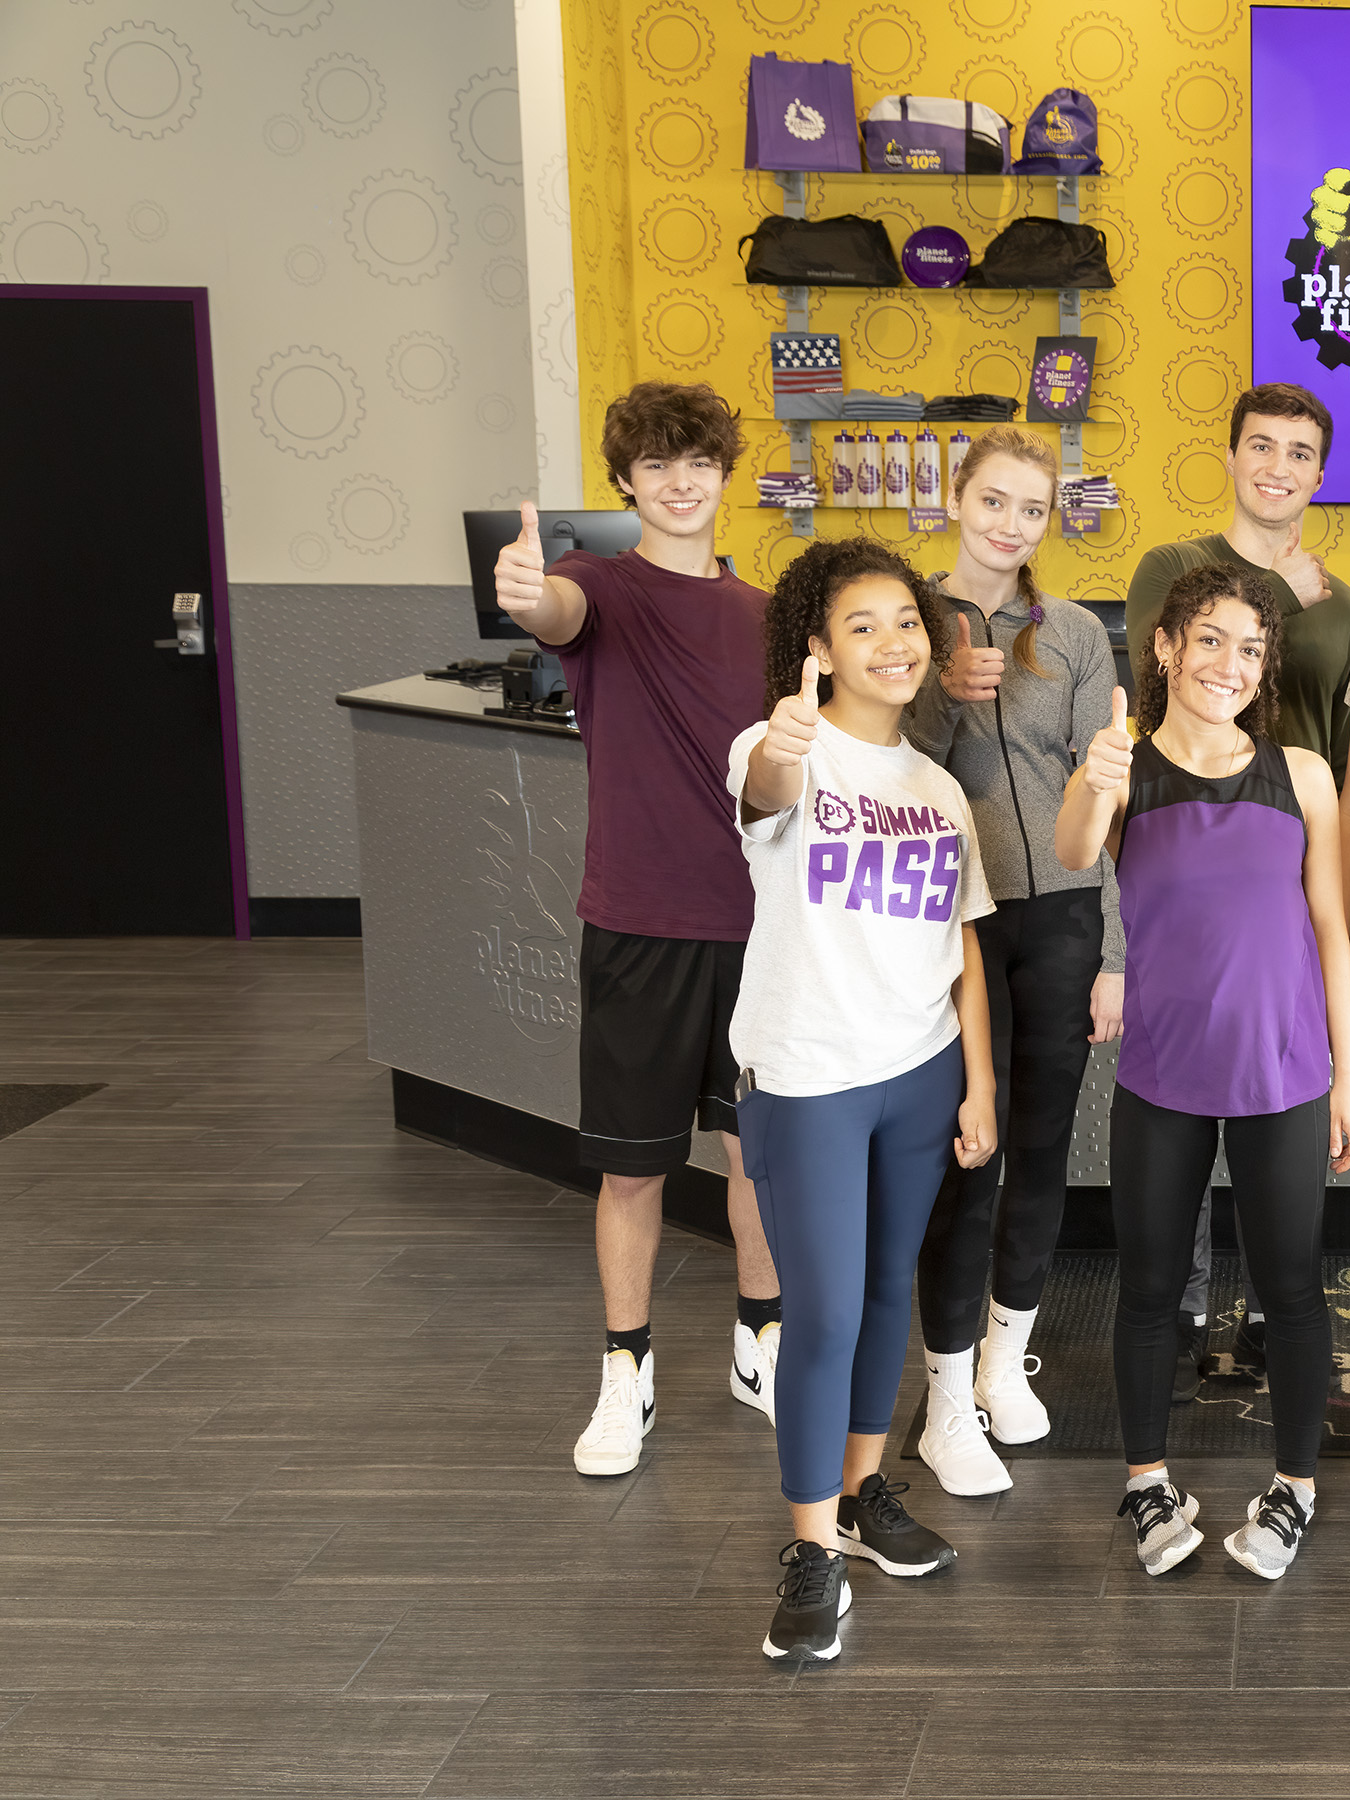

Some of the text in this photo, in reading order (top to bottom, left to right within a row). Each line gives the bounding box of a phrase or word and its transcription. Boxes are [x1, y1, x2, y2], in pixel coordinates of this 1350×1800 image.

[916, 246, 948, 257] planet
[920, 254, 954, 263] fitness
[1045, 370, 1072, 380] planet
[1048, 378, 1076, 387] fitness
[858, 794, 962, 837] SUMME
[807, 834, 960, 923] PASS
[472, 924, 578, 989] planet
[489, 967, 581, 1031] fitnes
